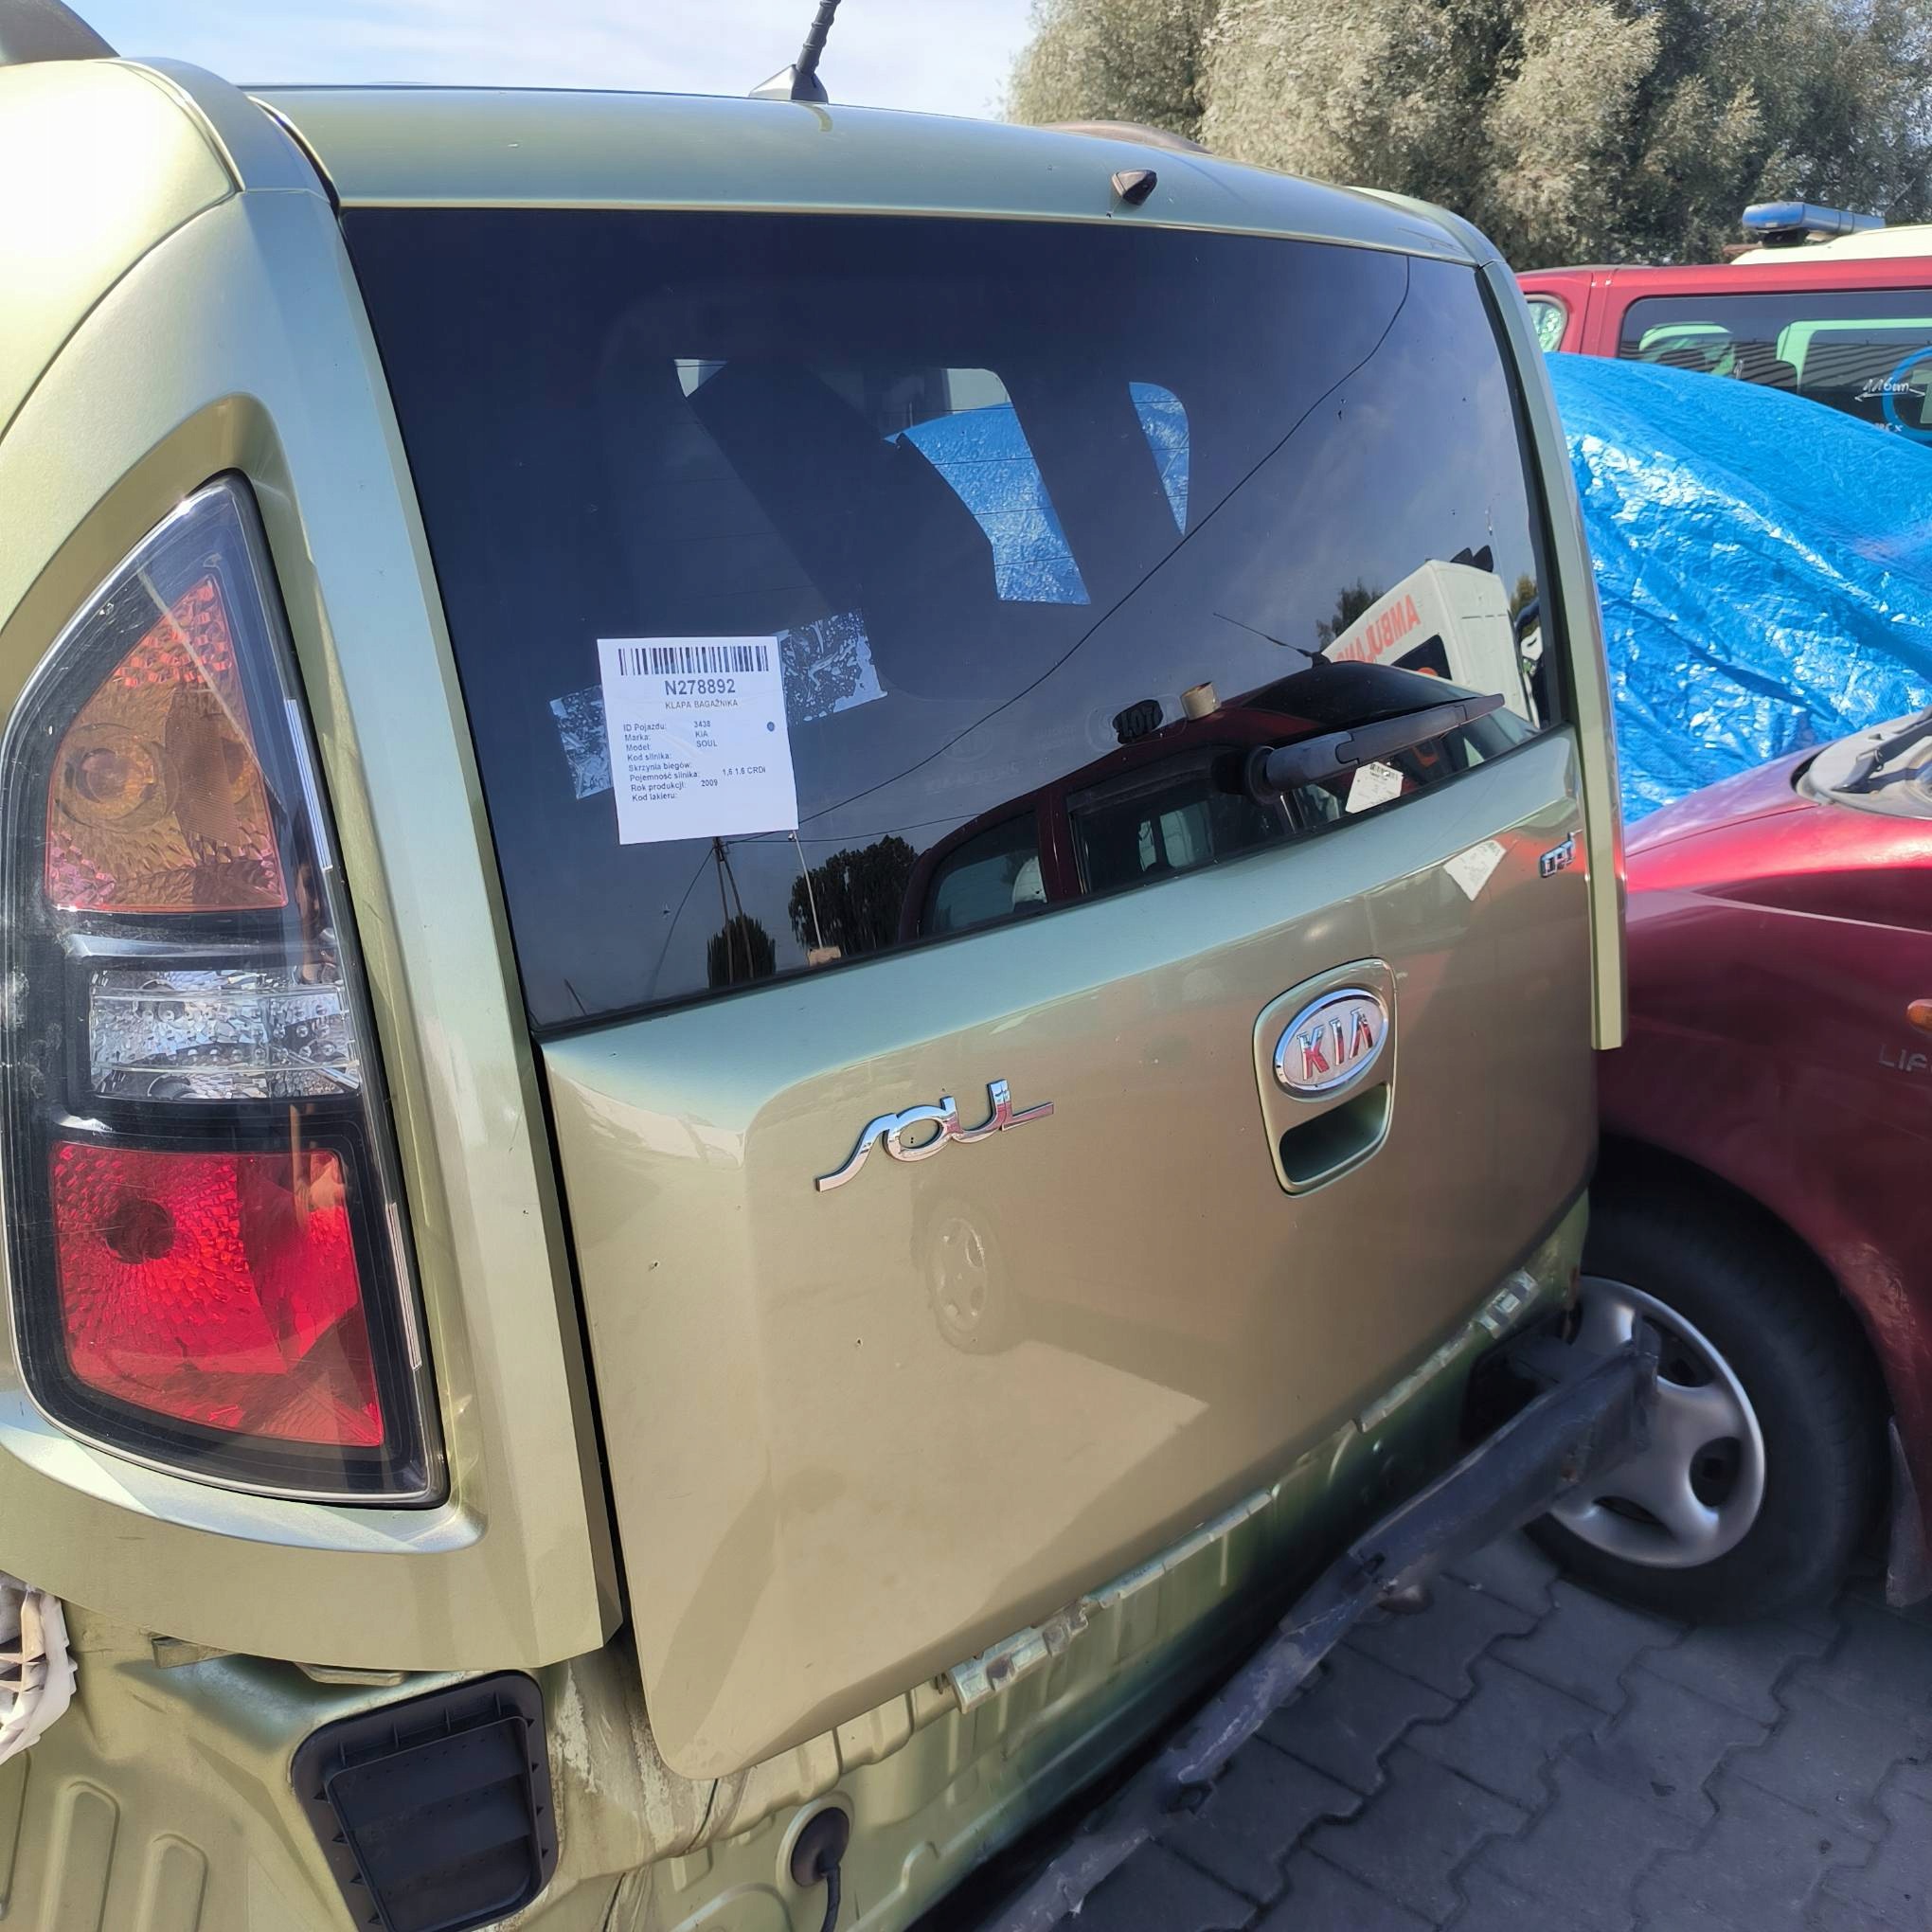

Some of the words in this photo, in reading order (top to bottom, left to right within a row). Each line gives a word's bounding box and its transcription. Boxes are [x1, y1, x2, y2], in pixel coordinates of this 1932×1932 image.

[665, 678, 736, 695] N278892
[665, 701, 691, 709] KLAPA
[694, 699, 739, 708] BAGAŻNIKA
[696, 739, 718, 748] SOUL
[627, 753, 643, 761] Kod
[628, 763, 662, 773] Skrzynia
[701, 778, 719, 787] 2009
[631, 784, 647, 793] Rok
[632, 794, 648, 802] Kod
[1297, 1006, 1374, 1082] KIA
